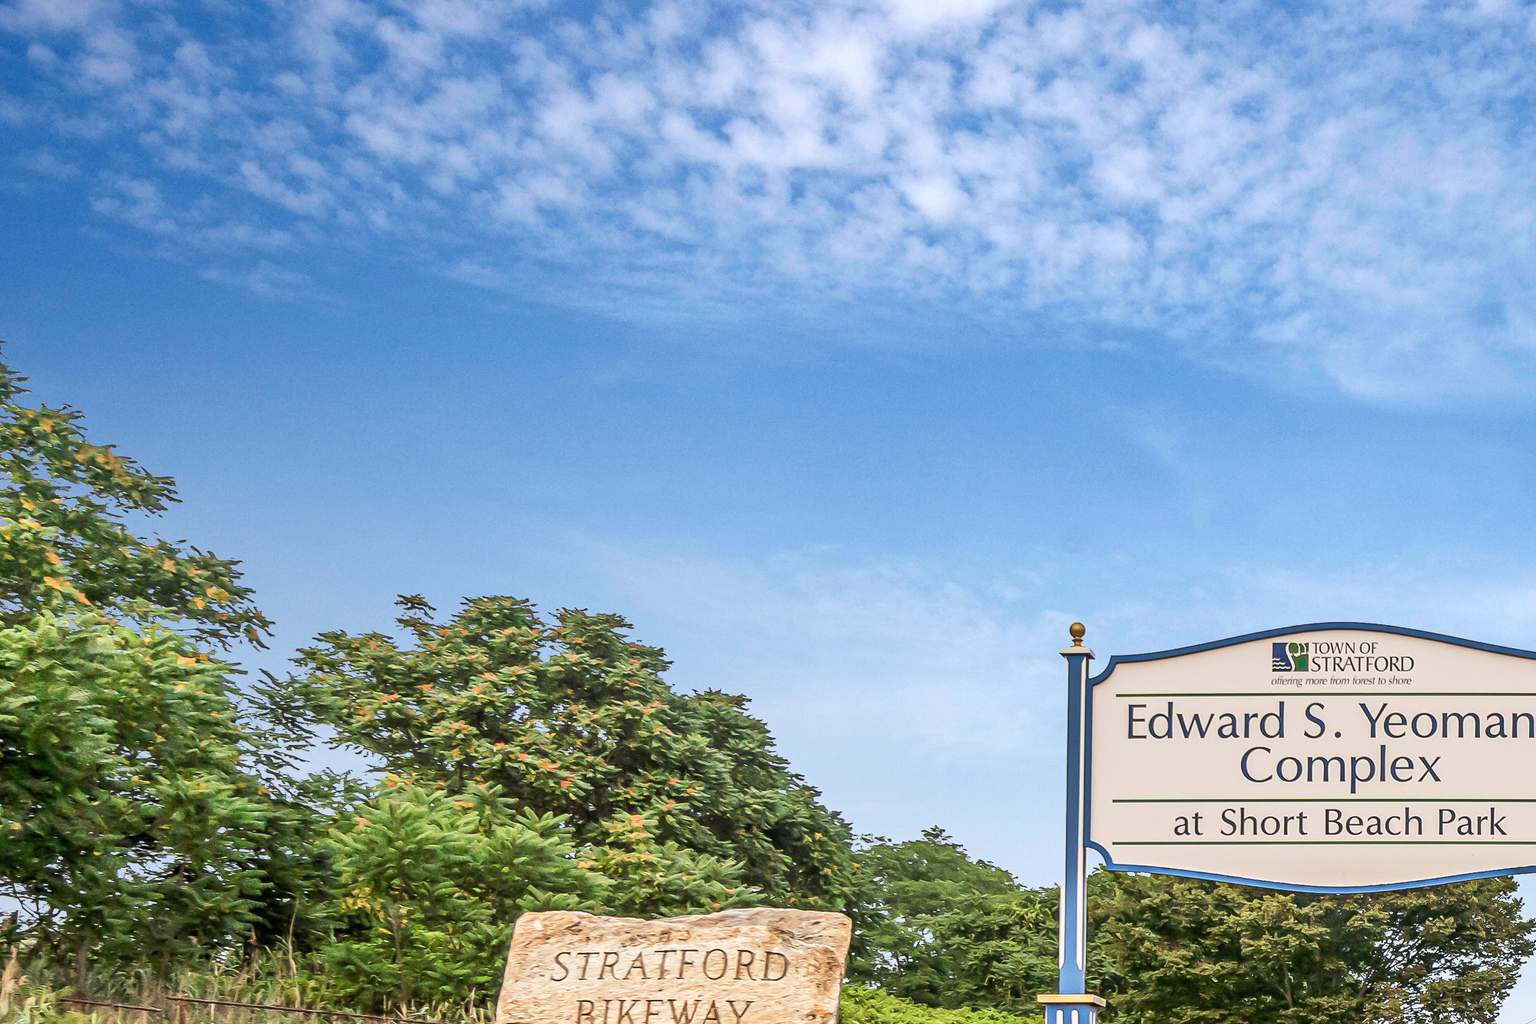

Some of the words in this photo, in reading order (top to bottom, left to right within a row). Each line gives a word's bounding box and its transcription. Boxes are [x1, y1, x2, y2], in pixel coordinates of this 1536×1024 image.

[1311, 642, 1355, 654] TOWN
[1359, 642, 1379, 654] OF
[1311, 656, 1415, 672] STRATFORD
[1271, 676, 1303, 688] offering
[1330, 676, 1350, 685] from
[1352, 676, 1376, 686] forest
[1378, 677, 1387, 685] to
[1388, 676, 1412, 685] shore
[1127, 701, 1286, 740] Edward
[1303, 702, 1342, 740] S.
[1240, 745, 1442, 794] Complex
[1173, 811, 1204, 836] at
[1220, 808, 1308, 837] Short
[1325, 808, 1424, 837] Beach
[1437, 808, 1508, 837] Park
[550, 948, 791, 983] STRATFORD
